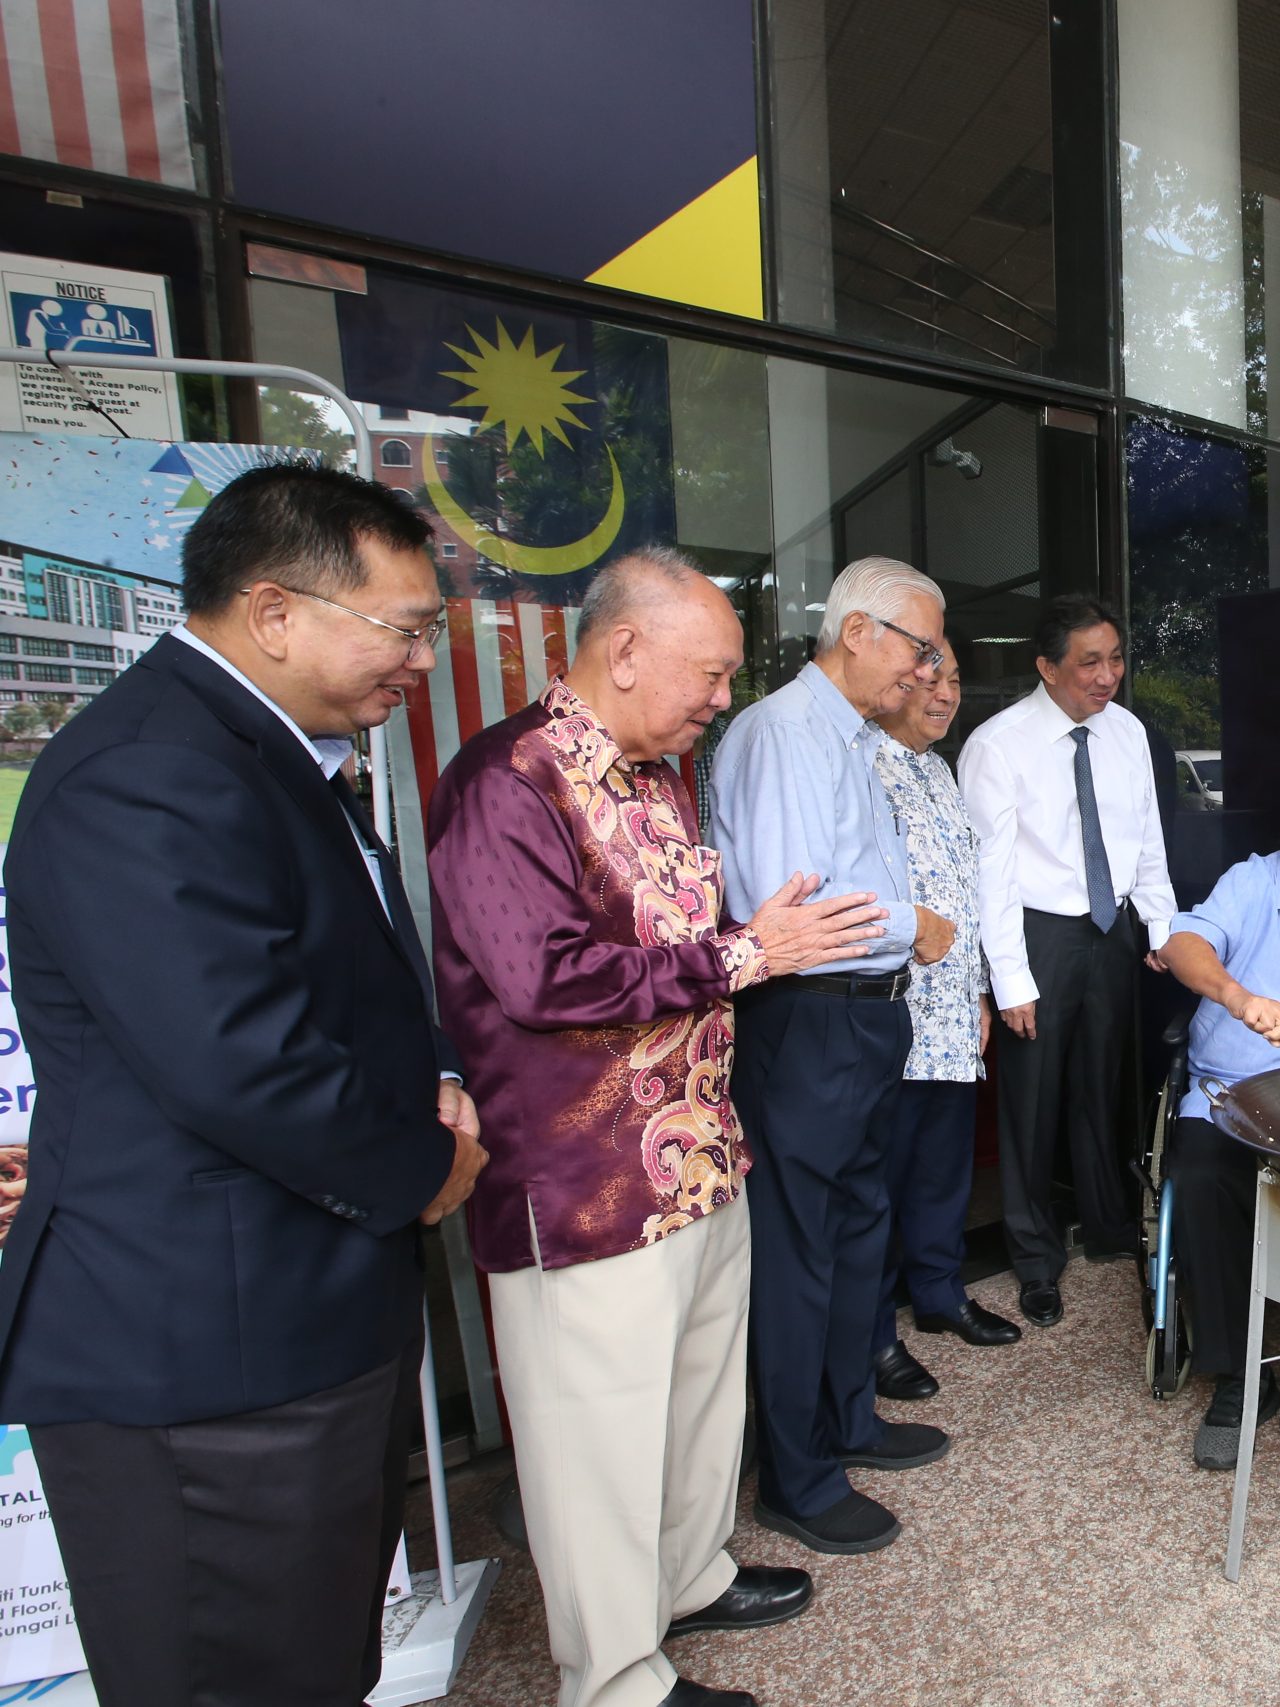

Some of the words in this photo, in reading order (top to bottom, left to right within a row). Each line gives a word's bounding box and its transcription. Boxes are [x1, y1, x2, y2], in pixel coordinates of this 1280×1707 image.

[56, 281, 107, 301] NOTICE
[18, 363, 33, 372] To
[79, 370, 103, 379] with
[89, 380, 124, 389] Access
[22, 391, 66, 401] register
[97, 398, 127, 406] guest
[23, 399, 68, 410] security
[106, 407, 133, 415] post.
[26, 415, 60, 425] Thank
[64, 420, 87, 428] you.
[17, 1513, 36, 1524] for
[11, 1600, 62, 1618] Floor,
